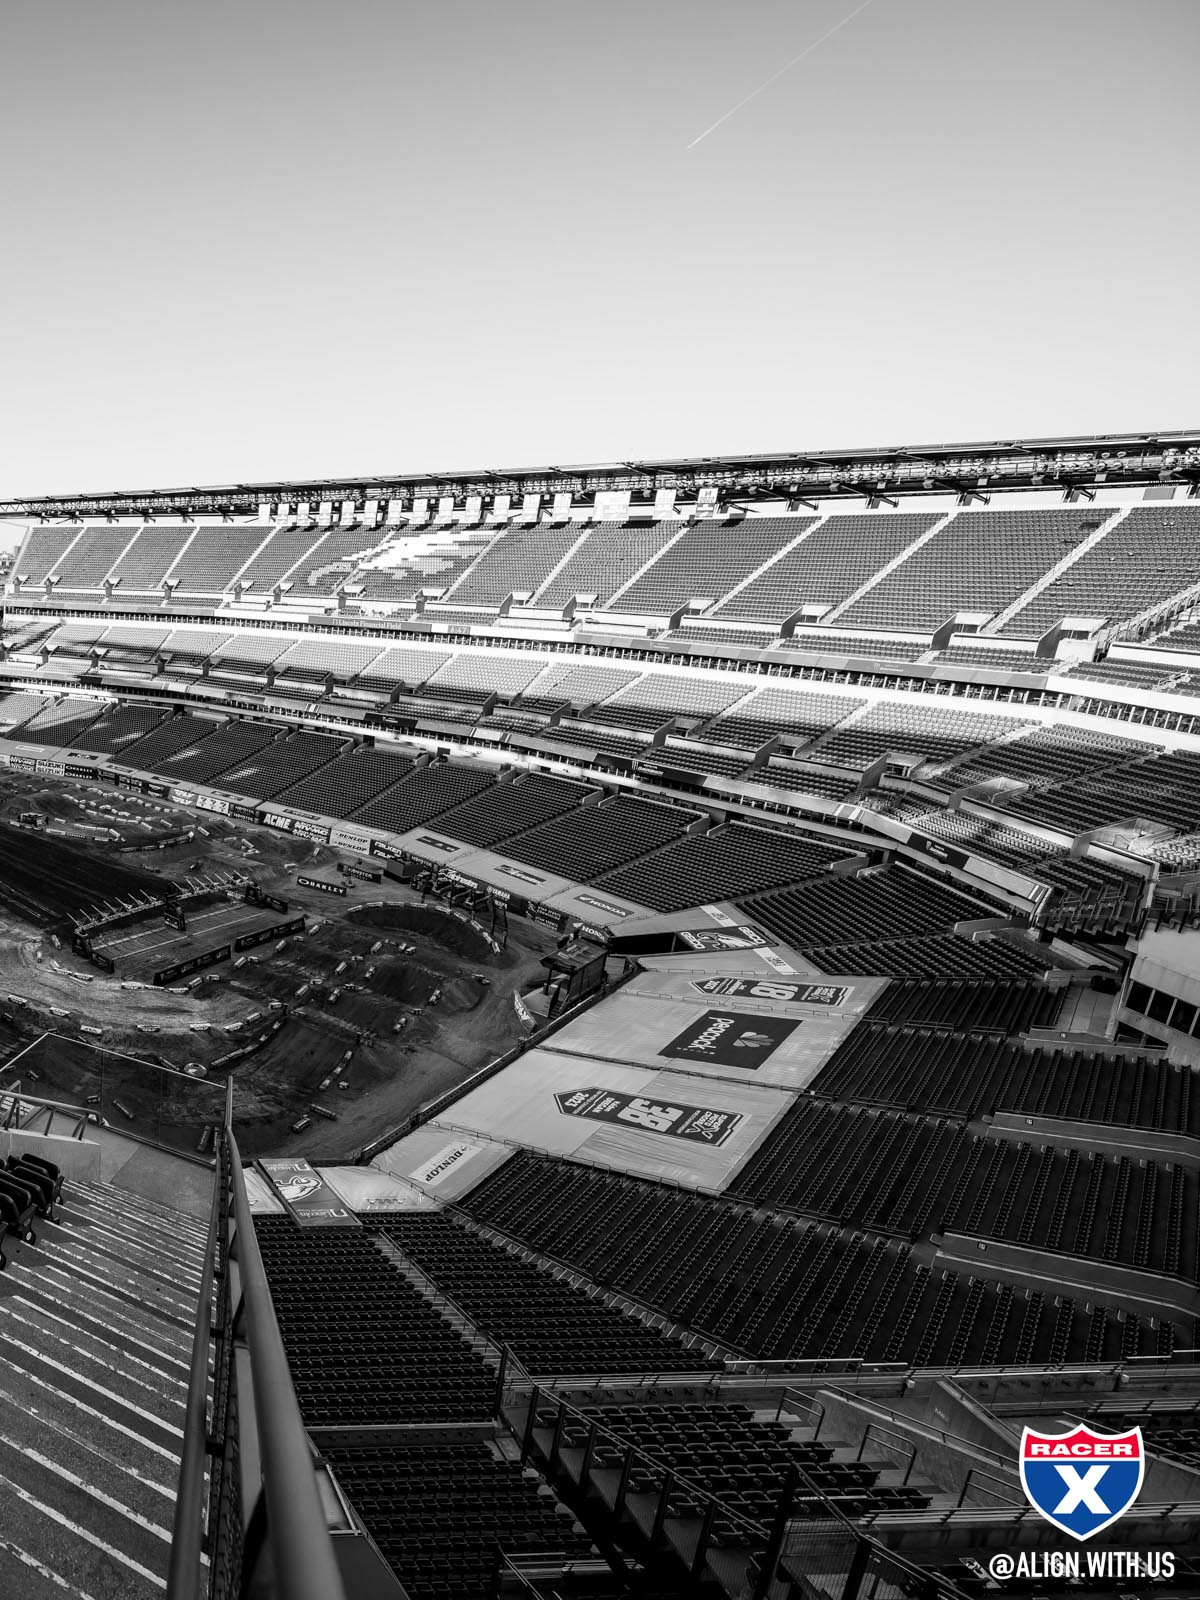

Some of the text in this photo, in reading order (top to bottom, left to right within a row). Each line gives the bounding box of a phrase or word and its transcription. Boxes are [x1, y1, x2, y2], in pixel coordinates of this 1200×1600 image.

[37, 767, 64, 776] SUZUKI
[38, 759, 64, 769] SUZUKI
[263, 813, 292, 830] ACME
[337, 841, 367, 851] DUNLOP
[338, 833, 368, 843] DUNLOP
[374, 841, 402, 855] FALKEN
[309, 881, 345, 895] OAKLEY
[590, 898, 627, 918] HONDA
[680, 931, 706, 950] GEICO
[738, 926, 766, 945] GEICO
[750, 981, 799, 1000] 18
[687, 1016, 735, 1050] peacock
[564, 1091, 590, 1107] 2023
[617, 1097, 684, 1132] 38
[425, 1150, 463, 1181] DUNLOP
